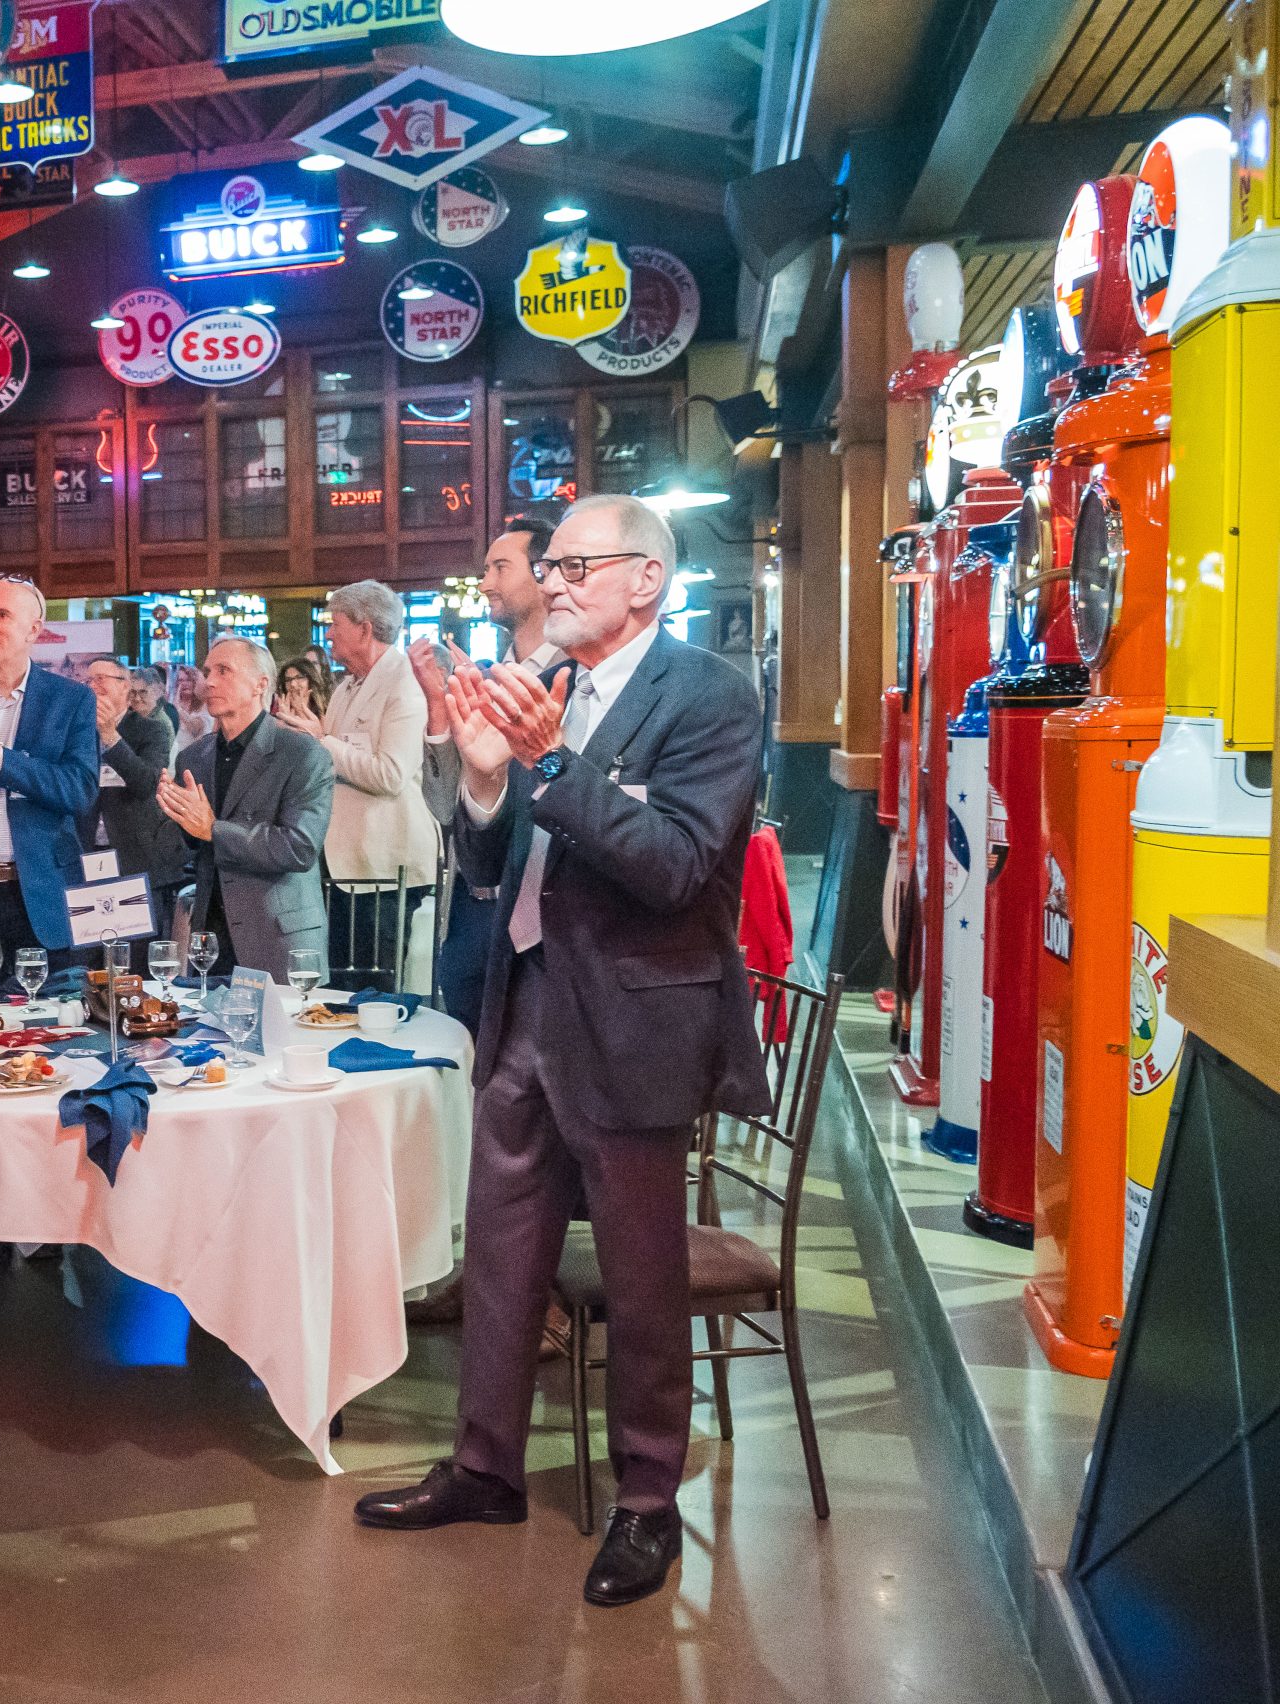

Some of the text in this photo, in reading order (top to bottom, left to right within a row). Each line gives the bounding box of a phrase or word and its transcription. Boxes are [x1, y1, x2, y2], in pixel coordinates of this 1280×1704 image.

[239, 0, 436, 39] OLDSMOBILE
[3, 90, 59, 123] BUICK
[16, 115, 89, 150] TRUCKS
[35, 164, 70, 184] STAR
[441, 204, 490, 219] NORTH
[446, 217, 485, 232] STAR
[180, 219, 309, 264] BUICK
[1132, 229, 1171, 291] ON
[119, 295, 170, 314] PURITY
[520, 287, 628, 318] RICHFIELD
[202, 321, 243, 331] IMPERIAL
[409, 308, 470, 325] NORTH
[416, 325, 461, 342] STAR
[596, 336, 681, 371] PRODUCTS
[201, 363, 243, 374] DEALER
[6, 469, 86, 494] BUCK
[1044, 907, 1070, 961] LION
